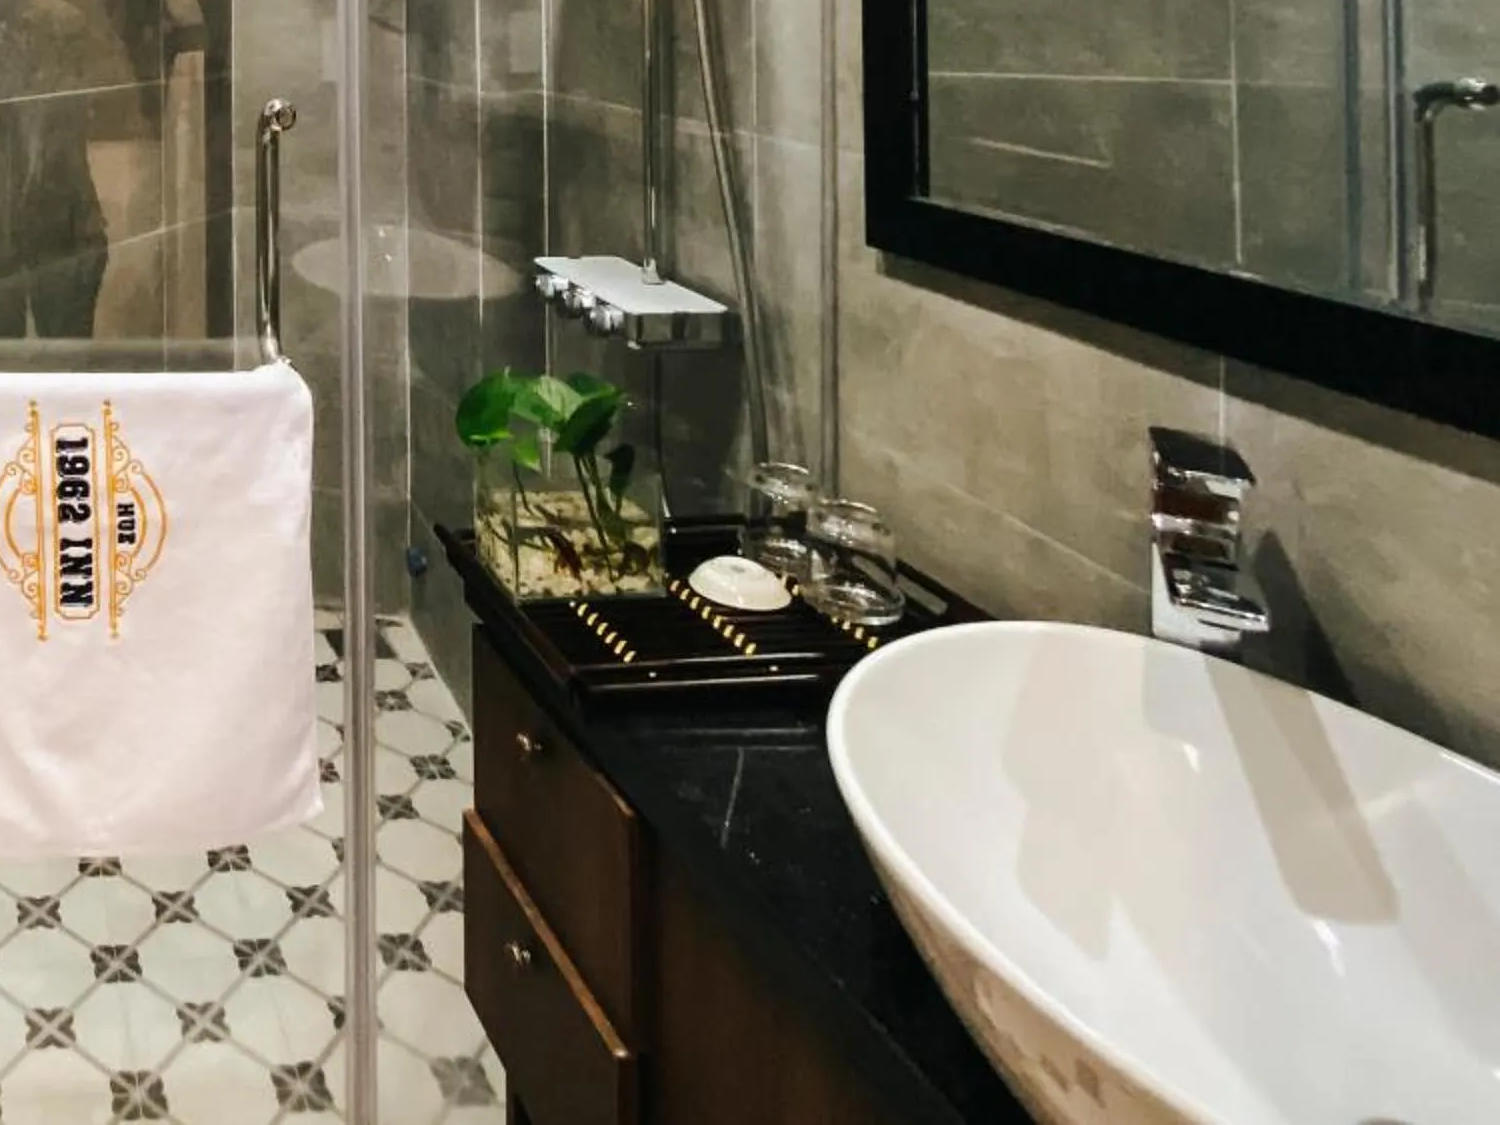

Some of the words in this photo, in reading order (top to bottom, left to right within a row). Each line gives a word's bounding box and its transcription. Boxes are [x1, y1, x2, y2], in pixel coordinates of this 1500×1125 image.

[55, 437, 92, 524] 1962
[116, 501, 137, 546] HUE
[59, 537, 94, 608] INN
